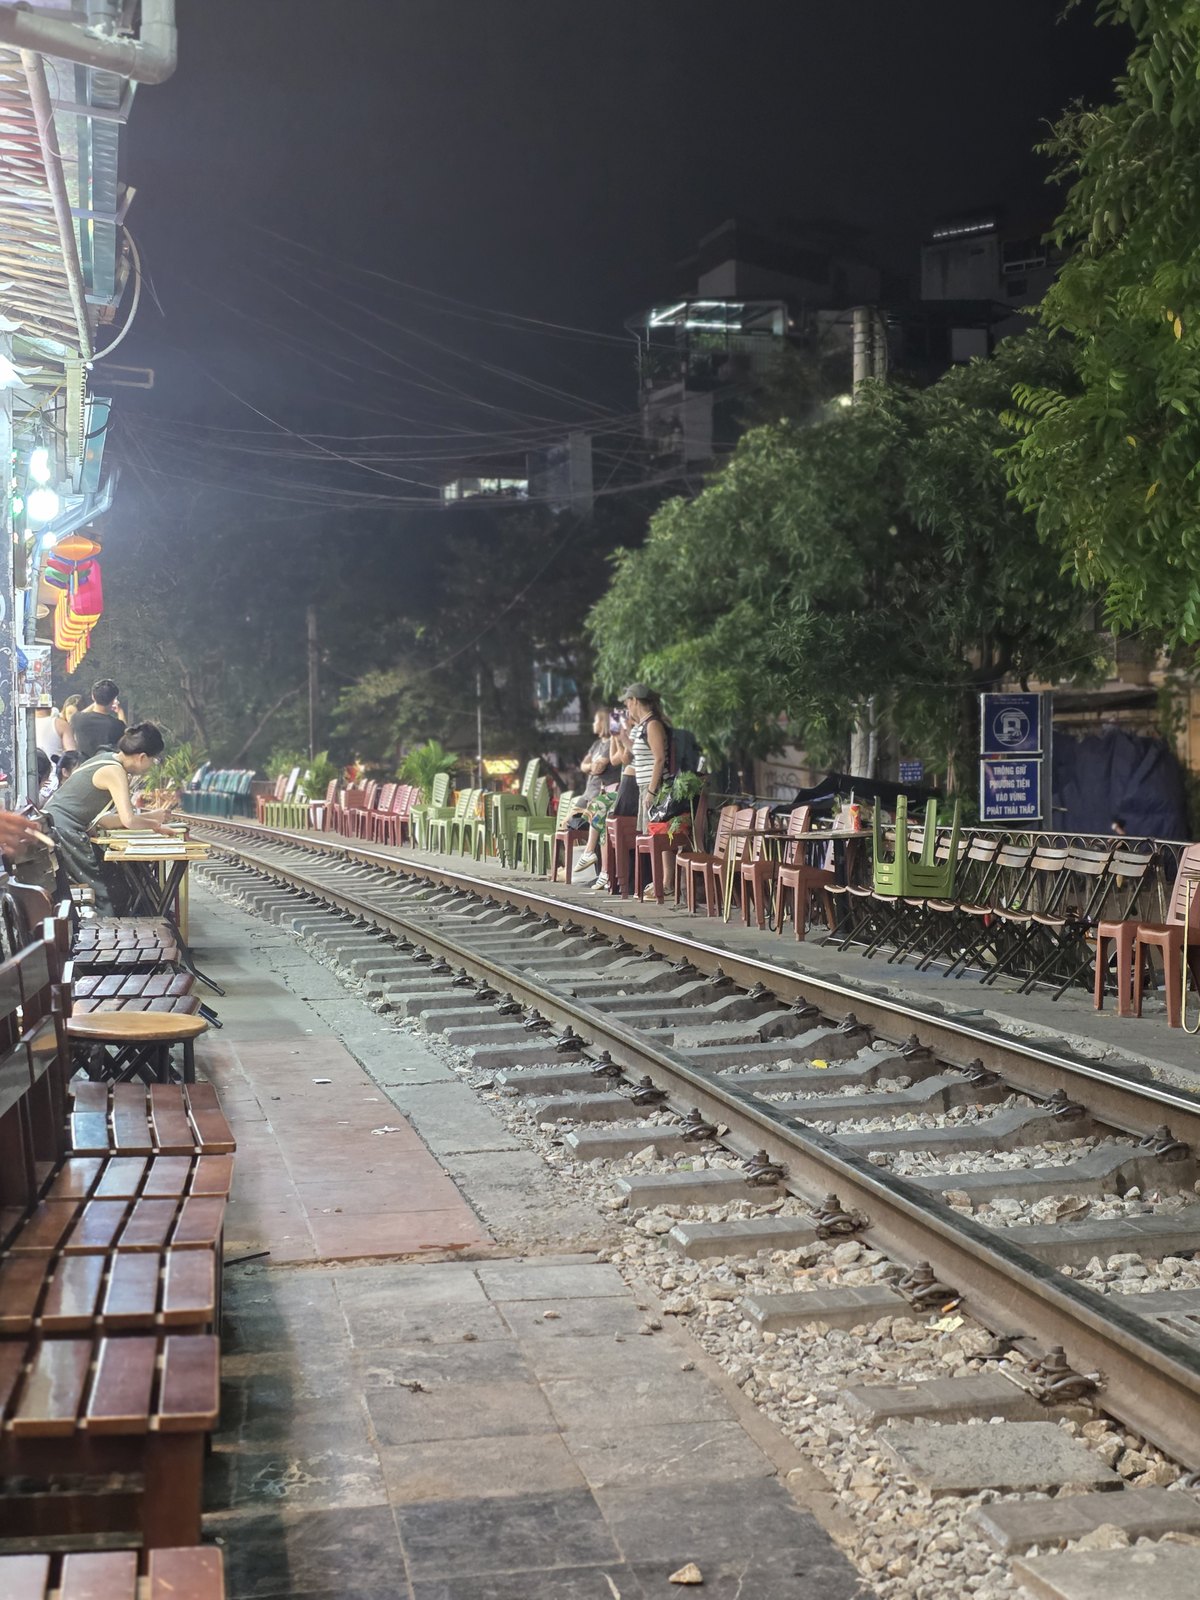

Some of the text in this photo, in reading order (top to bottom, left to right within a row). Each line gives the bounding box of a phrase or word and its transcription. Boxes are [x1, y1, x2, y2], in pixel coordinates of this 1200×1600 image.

[993, 765, 1014, 775] TRÔNG
[1016, 778, 1030, 790] TIỆN
[995, 791, 1026, 802] VÀO VÙNG
[986, 805, 1003, 815] PHÁT
[1004, 803, 1018, 815] THẢI
